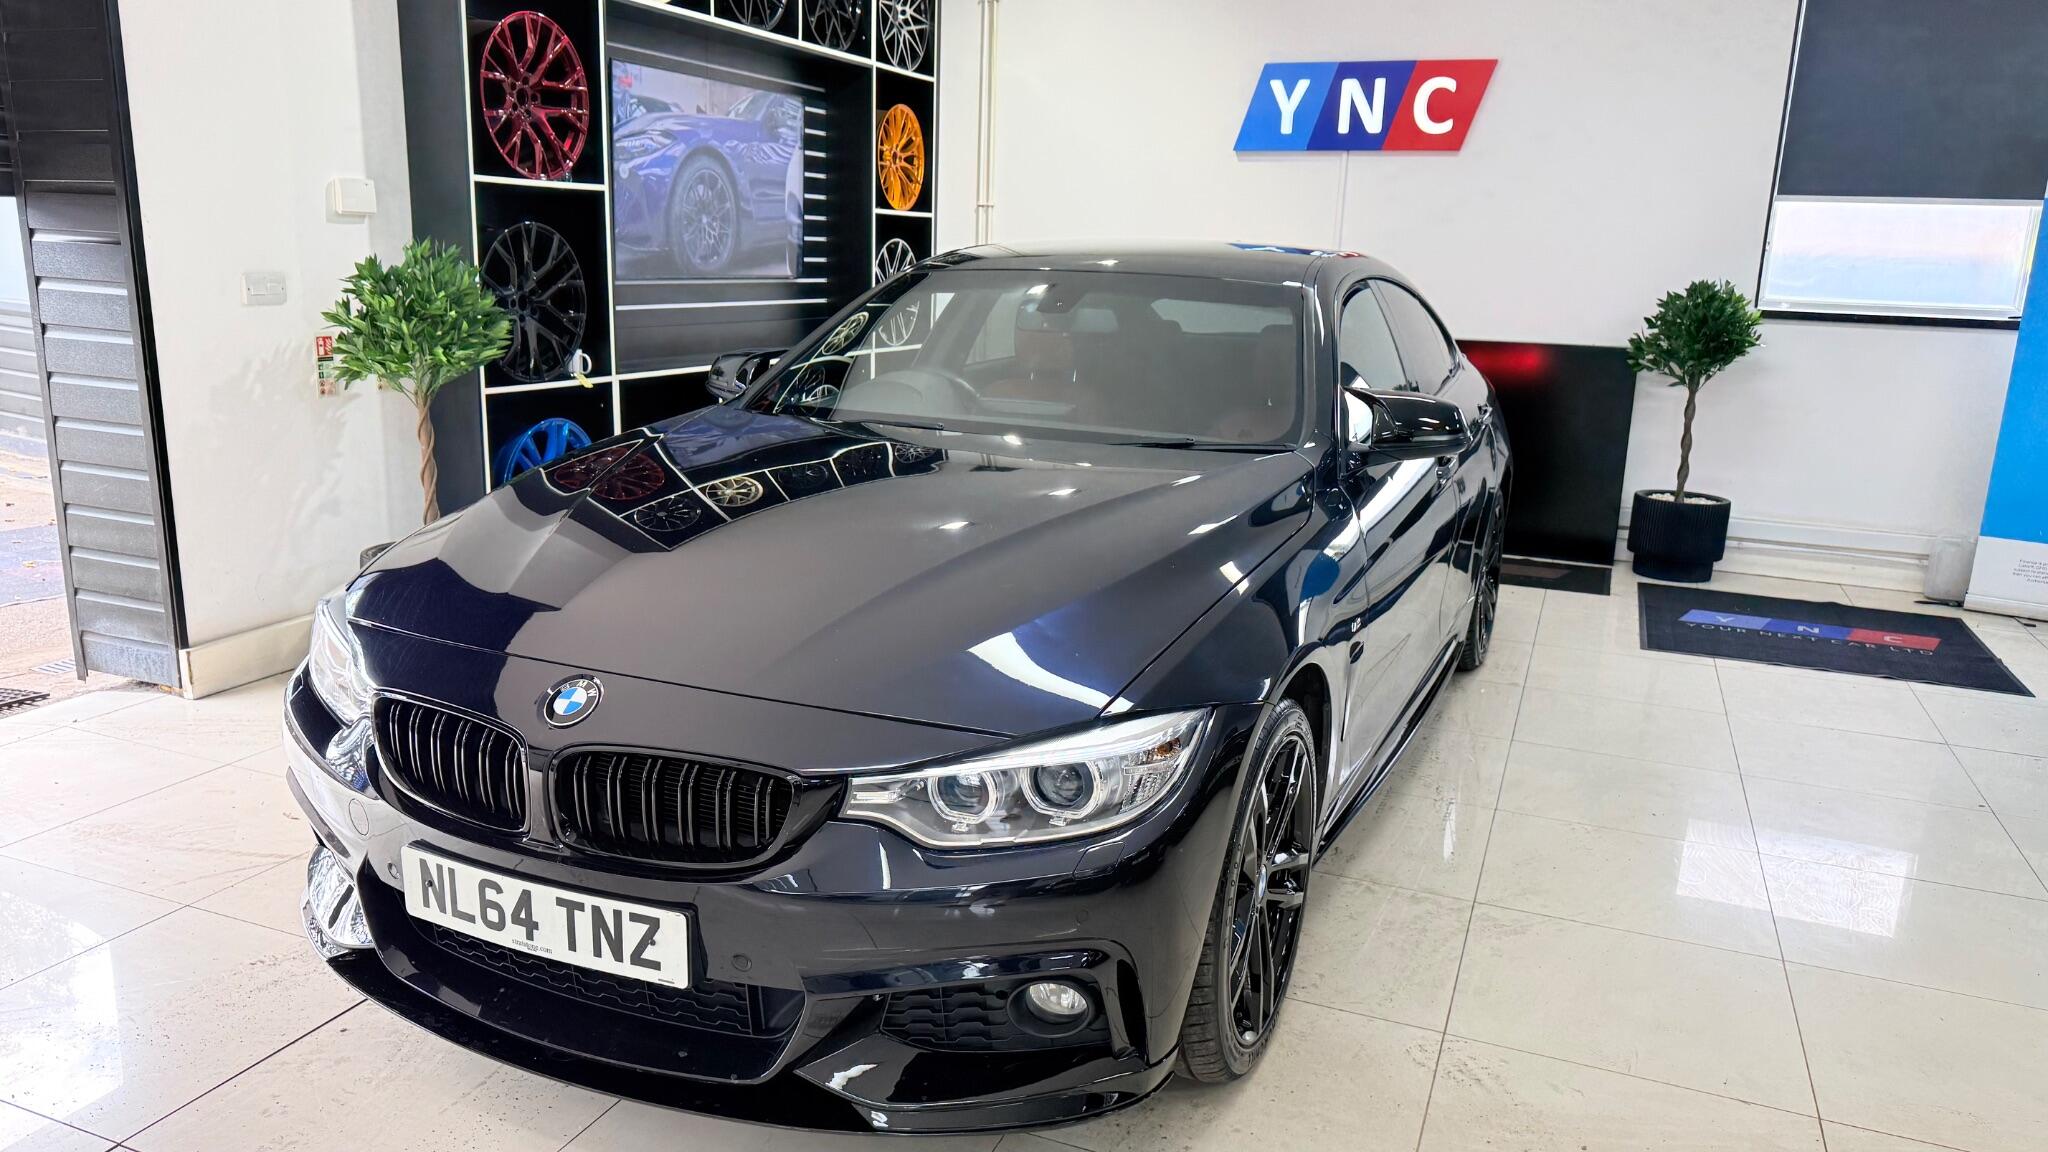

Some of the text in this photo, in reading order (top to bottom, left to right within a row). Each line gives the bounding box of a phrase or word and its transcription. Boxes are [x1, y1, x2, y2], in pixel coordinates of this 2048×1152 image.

[1269, 76, 1457, 135] YNC
[1686, 622, 1934, 655] YOUR NEXT CAR LTD
[560, 680, 598, 697] BMW
[419, 857, 661, 971] NL64 TNZ
